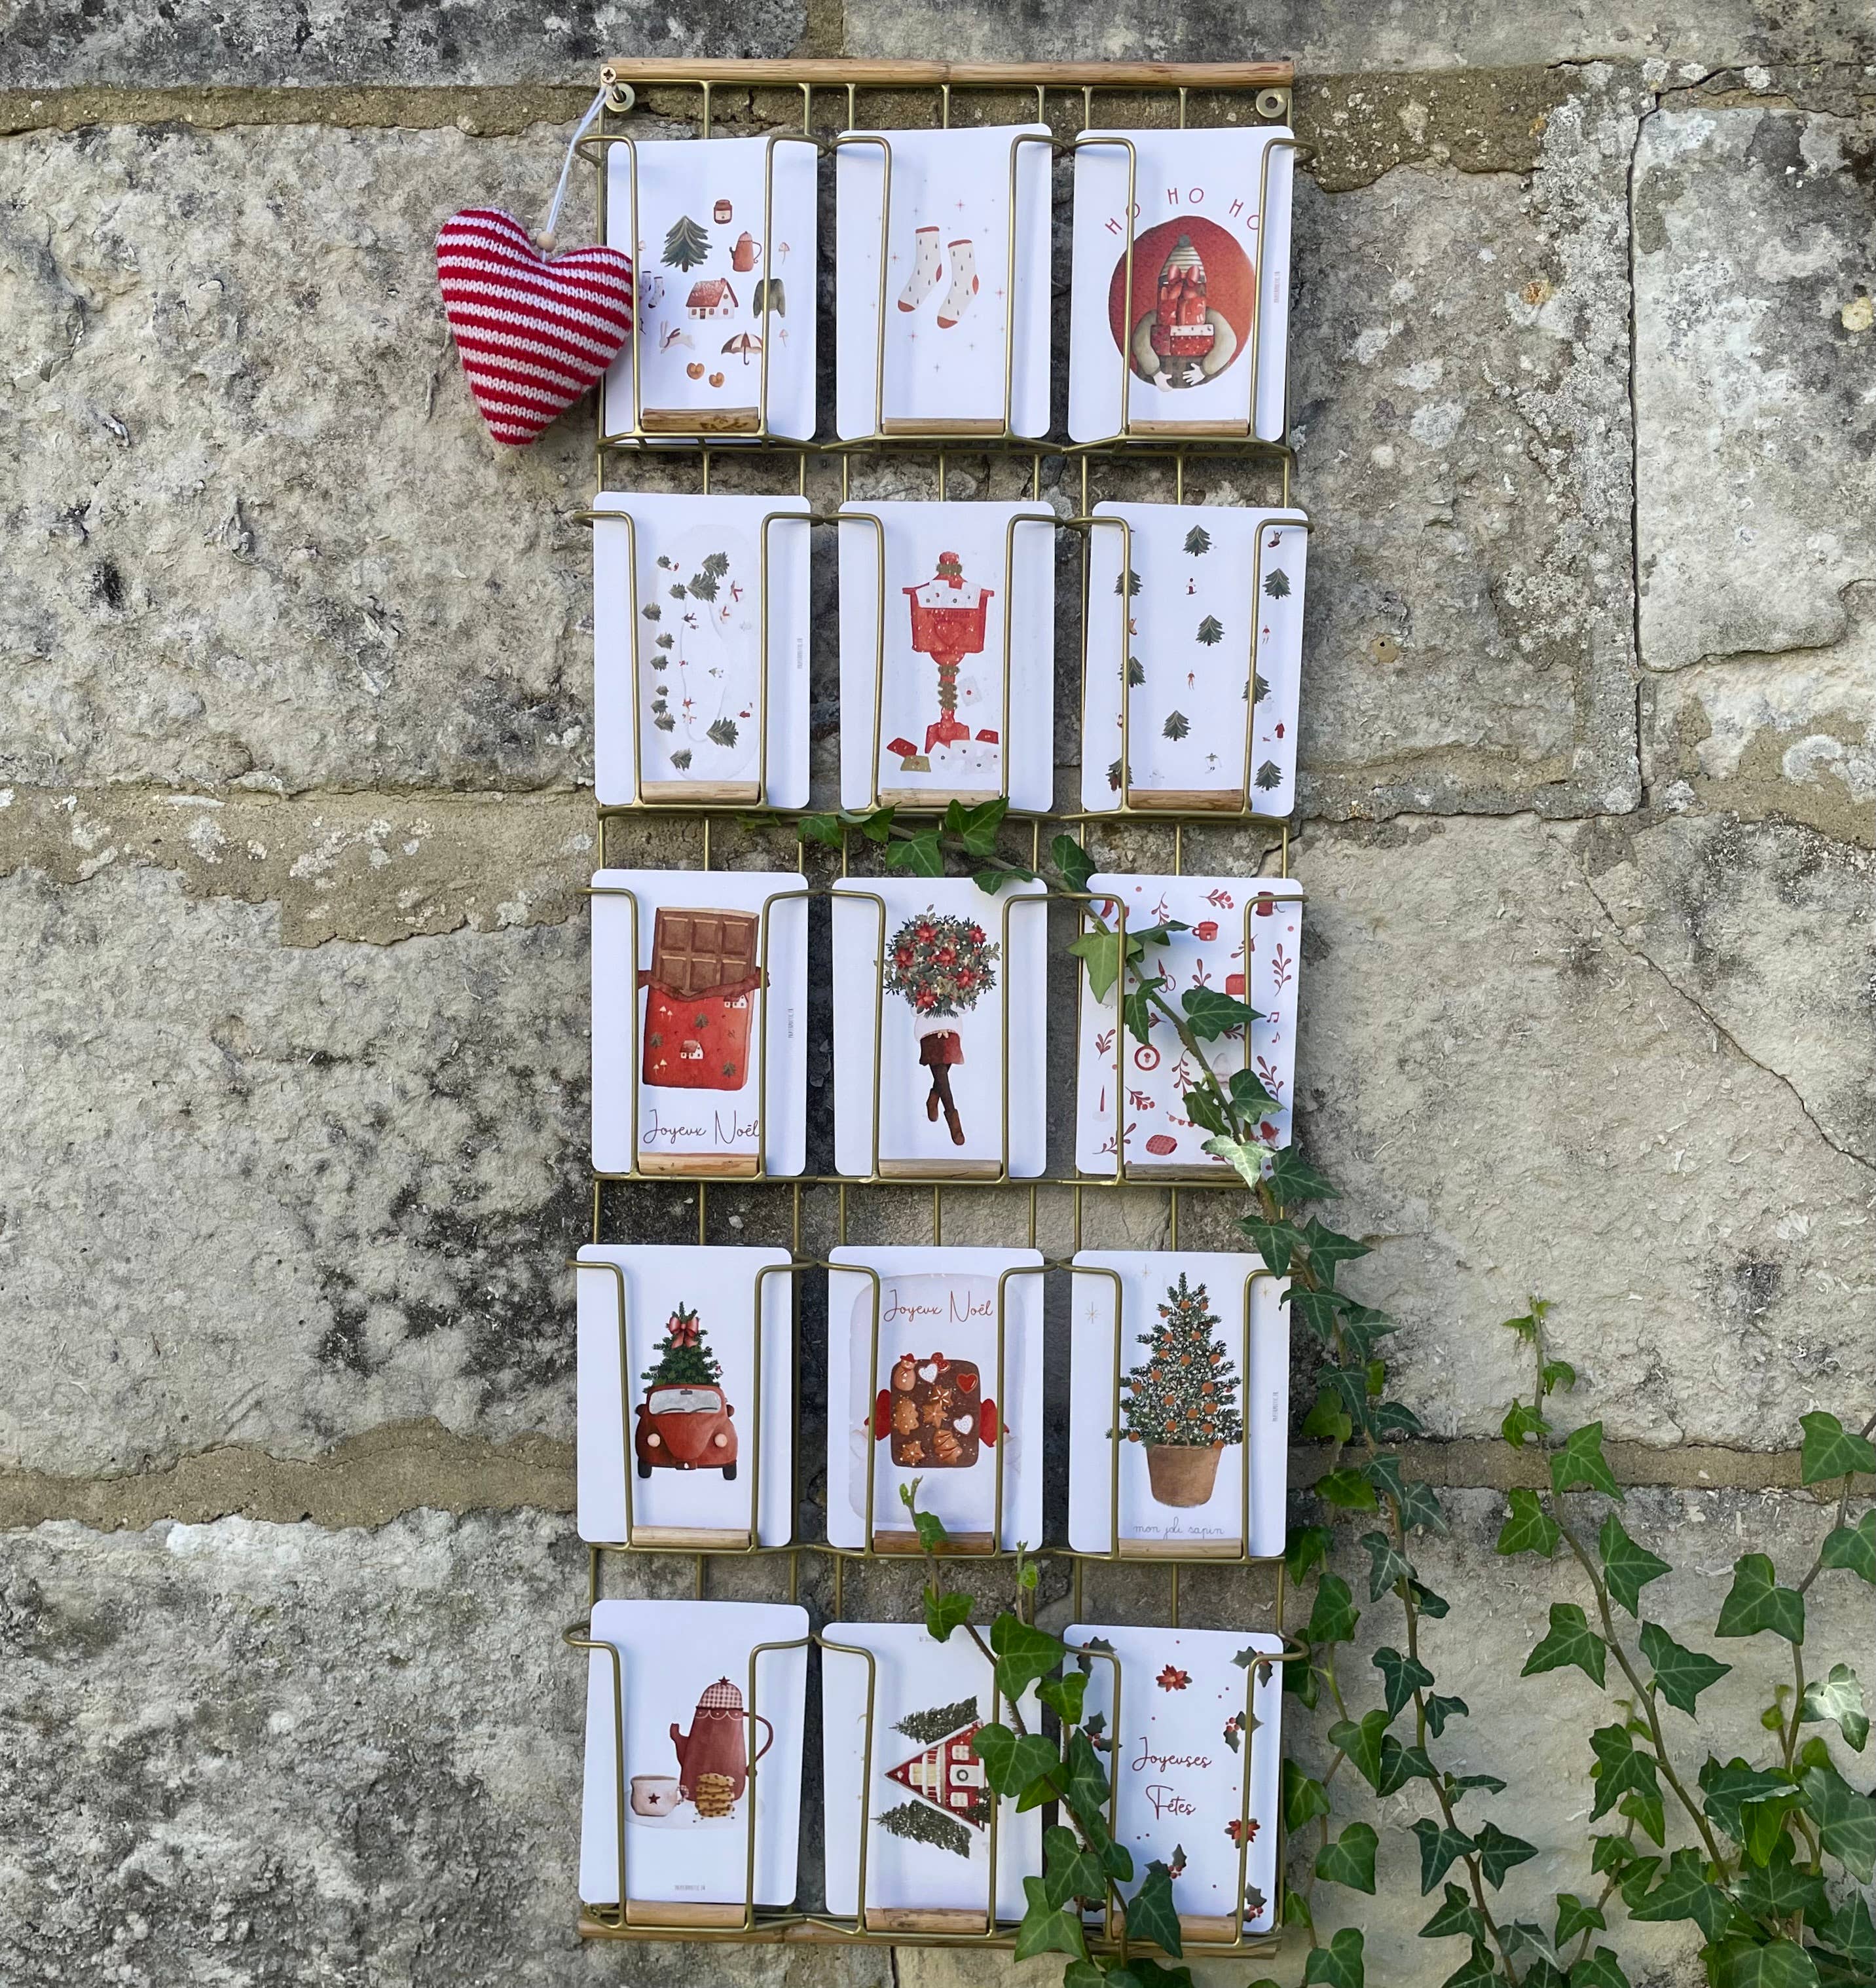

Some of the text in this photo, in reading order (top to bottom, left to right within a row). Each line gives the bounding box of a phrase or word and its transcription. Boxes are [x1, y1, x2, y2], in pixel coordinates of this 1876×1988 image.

[1105, 187, 1259, 235] HO HO HO
[643, 1109, 760, 1145] Joyeux Noël
[883, 1289, 993, 1323] Joyeux Noël
[1133, 1516, 1225, 1539] mon joli sapin
[1132, 1736, 1212, 1773] Joyeuses
[1145, 1784, 1196, 1820] Fêtes
